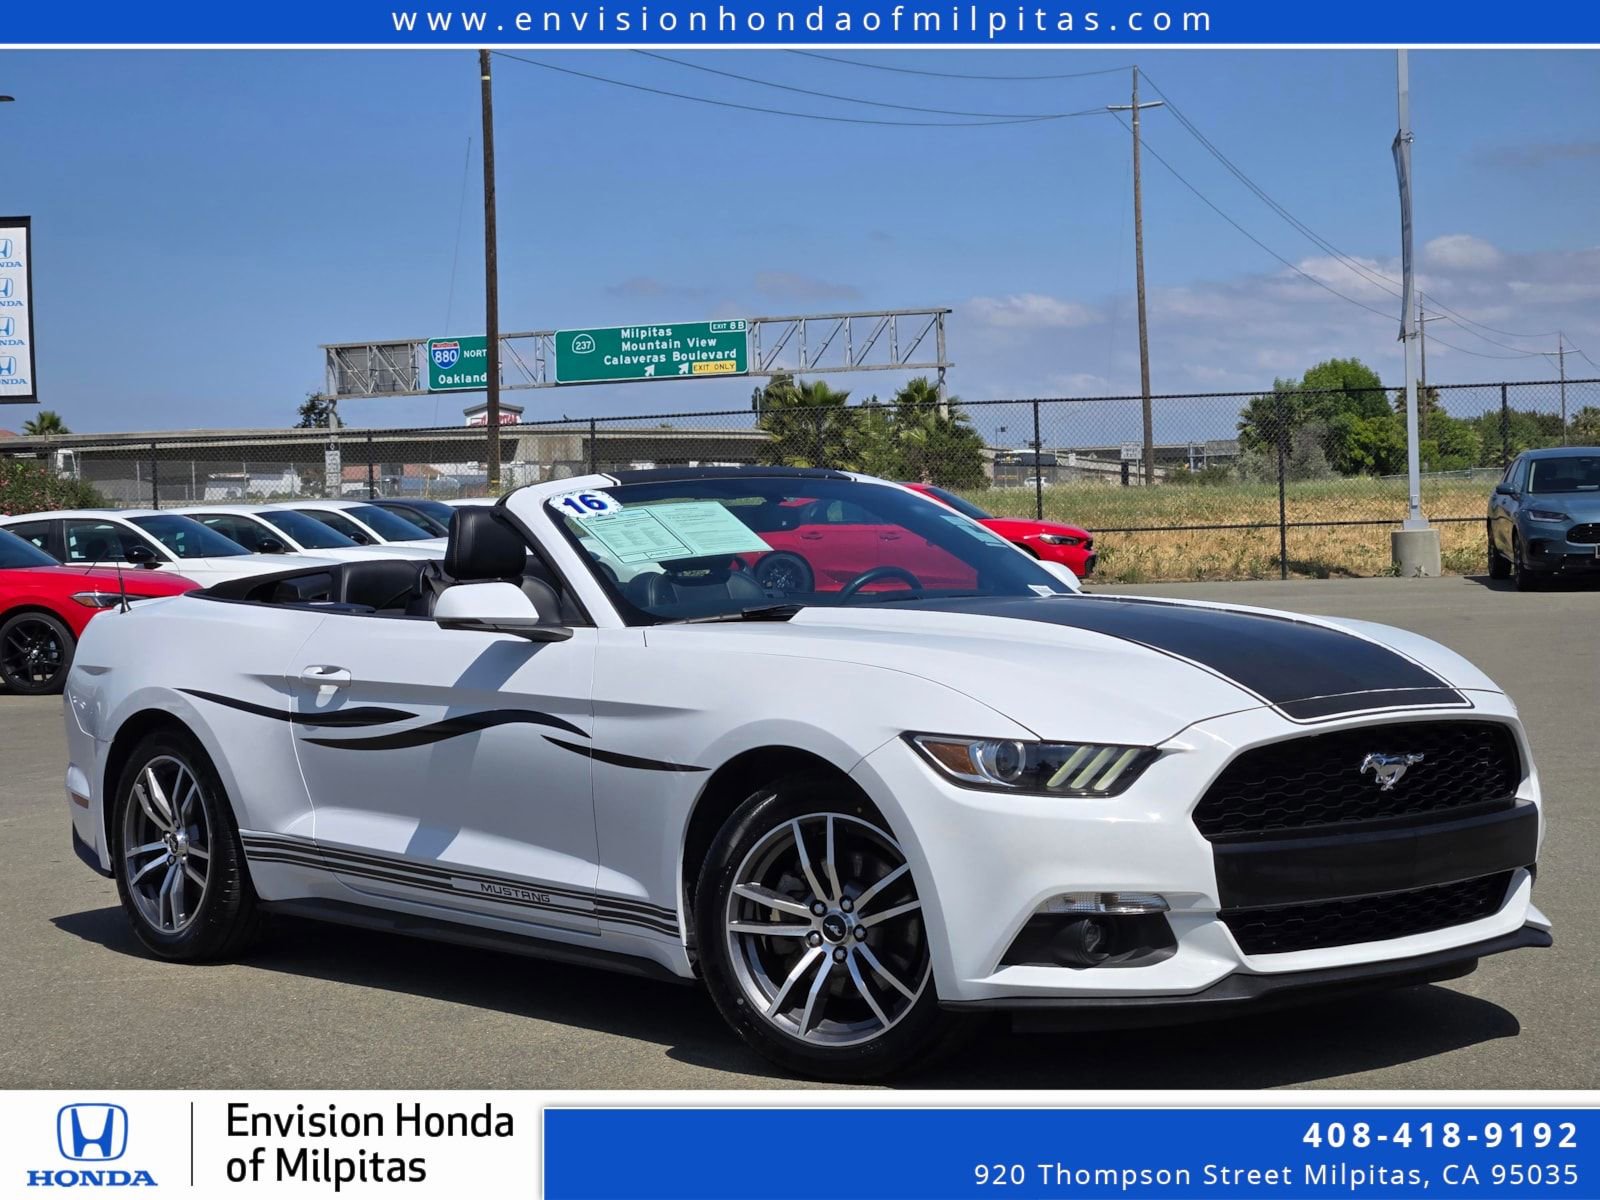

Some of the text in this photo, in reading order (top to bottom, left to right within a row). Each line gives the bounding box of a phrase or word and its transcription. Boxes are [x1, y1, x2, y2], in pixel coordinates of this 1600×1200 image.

[621, 327, 672, 340] Milpitas
[575, 340, 592, 351] 237
[621, 337, 717, 352] Mountain View
[435, 350, 458, 363] 880
[463, 349, 487, 358] NORT
[604, 348, 737, 366] Calaveras Boulevard
[693, 362, 735, 372] EXIT ONLY
[438, 372, 487, 385] Oakland
[562, 494, 608, 514] 16
[480, 883, 551, 903] MUSTANG
